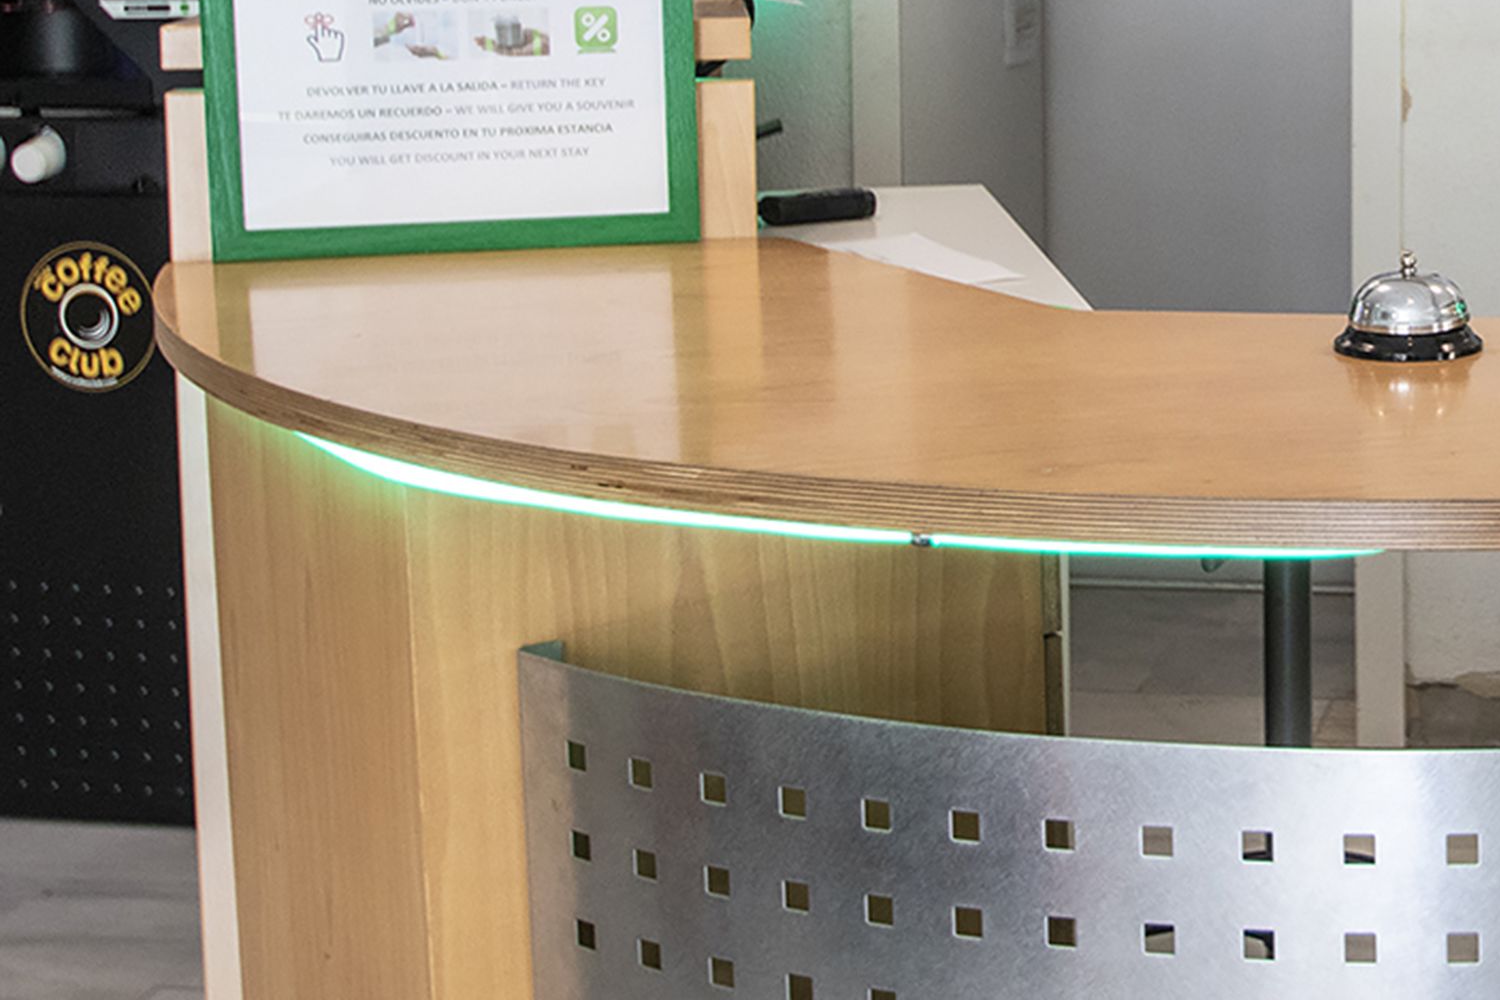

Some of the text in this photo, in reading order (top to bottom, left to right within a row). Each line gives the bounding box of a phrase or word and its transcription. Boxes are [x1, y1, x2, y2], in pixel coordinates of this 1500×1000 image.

[307, 85, 369, 97] DEVOLVER
[372, 84, 388, 94] TU
[390, 83, 425, 94] LLAVE
[428, 83, 438, 93] A
[440, 82, 454, 92] LA
[457, 81, 498, 92] SALIDA
[511, 79, 557, 90] RETURN
[561, 78, 580, 88] THE
[583, 77, 606, 87] KEY
[358, 109, 376, 119] UN
[379, 106, 442, 118] RECUERDO
[455, 105, 473, 115] WE
[477, 104, 504, 115] WILL
[507, 103, 533, 113] GIVE
[537, 102, 562, 112] YOU
[576, 99, 635, 110] SOUVENIR
[303, 131, 387, 144] CONSEGUIRAS
[390, 128, 459, 141] DESCUENTO
[463, 128, 478, 138] EN
[482, 127, 497, 137] TU
[558, 123, 613, 135] ESTANCIA
[329, 147, 590, 167] YOU WILL GET DISCOUNT IN YOUR NEXT STAY
